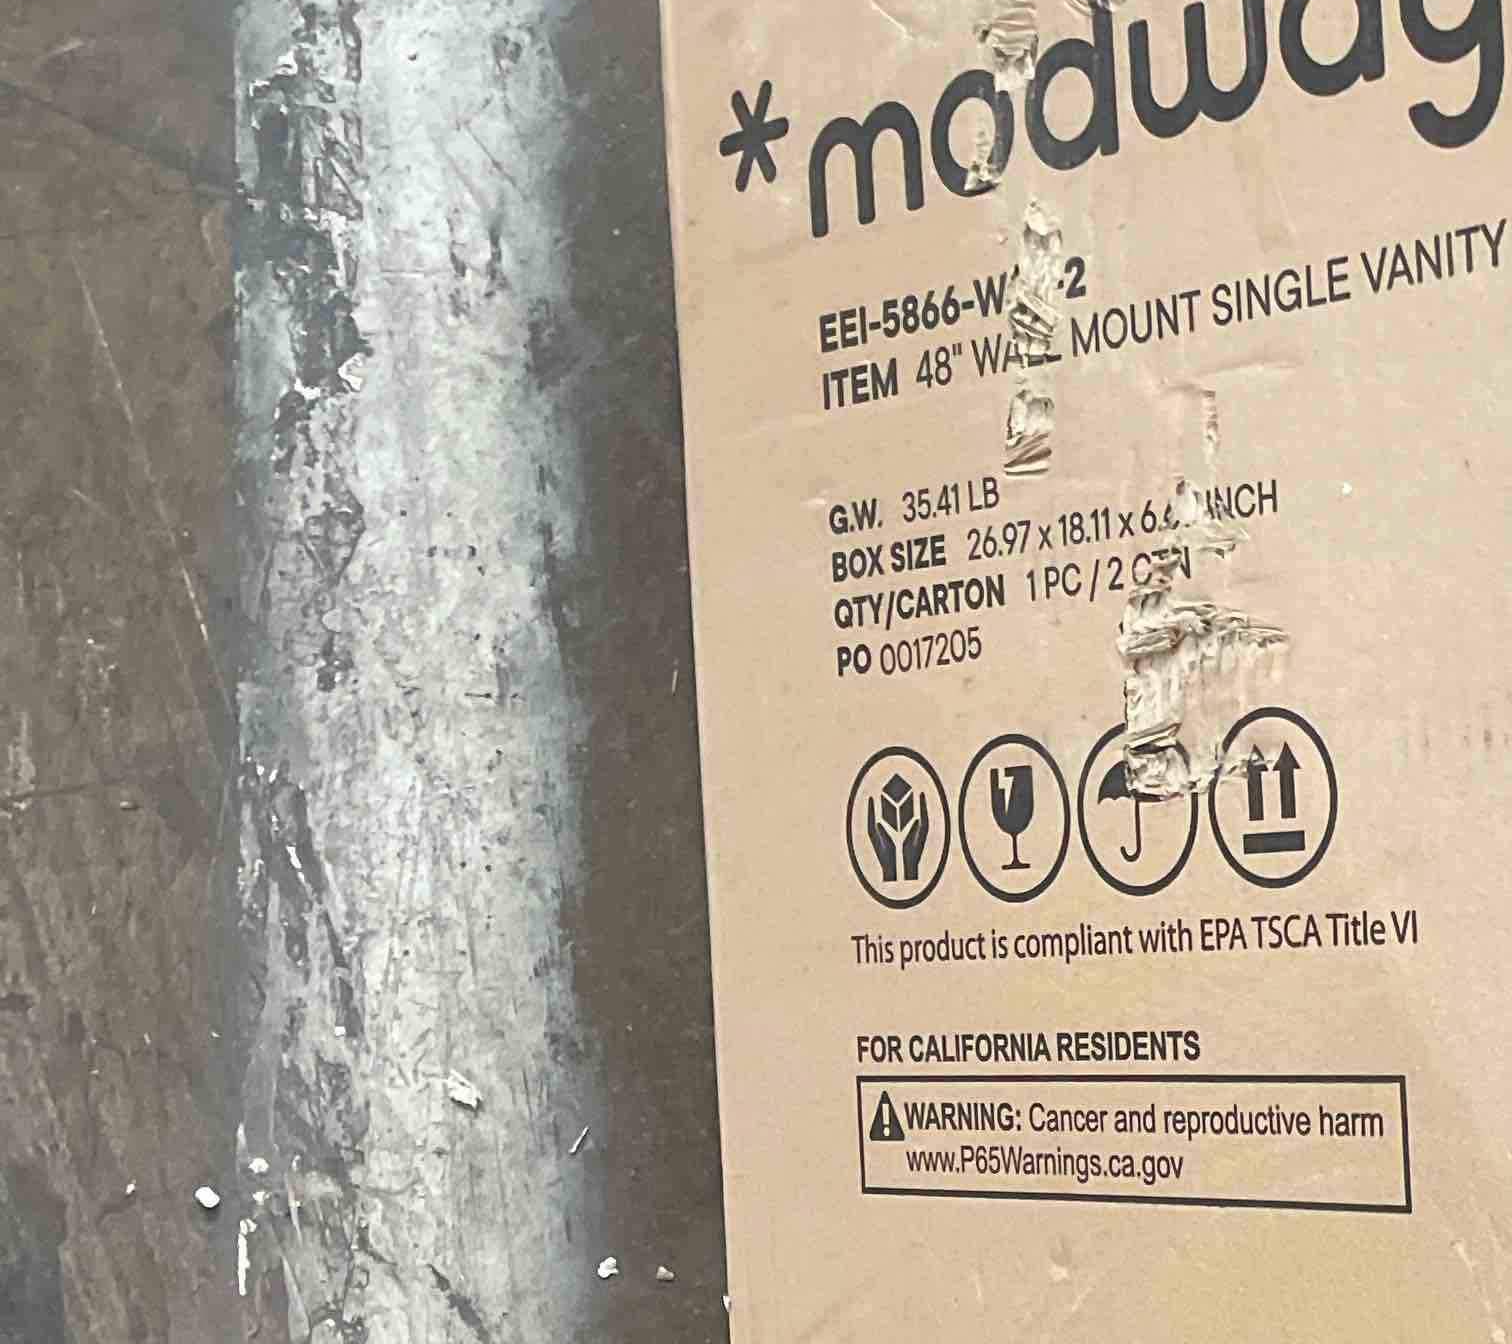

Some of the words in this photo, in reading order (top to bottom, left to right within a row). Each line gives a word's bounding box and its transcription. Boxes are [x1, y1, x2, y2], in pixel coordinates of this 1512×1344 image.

[819, 255, 1087, 354] EEI-5866-W-2
[822, 357, 899, 411] ITEM
[915, 342, 962, 389] 48"
[1070, 289, 1201, 358] MOUNT
[1211, 255, 1352, 327] SINGLE
[1359, 218, 1507, 294] VANITY
[828, 497, 883, 535] G.W.
[901, 483, 961, 524] 35.41
[967, 476, 1000, 512] LB
[831, 543, 885, 584] BOX
[889, 533, 947, 573] SIZE
[966, 519, 1031, 562] 26.97
[1057, 505, 1111, 547] 18.11
[1205, 478, 1279, 522] INCH
[833, 572, 1006, 632] QTY/CARTON
[1107, 556, 1125, 592] 2
[836, 642, 873, 678] PO
[879, 625, 983, 677] 0017205
[850, 933, 895, 964] This
[899, 929, 987, 971] product
[990, 928, 1009, 960] is
[1013, 922, 1134, 965] compliant
[1138, 918, 1194, 954] with
[1199, 917, 1248, 952] EPA
[1250, 913, 1323, 949] TSCA
[1325, 909, 1387, 947] Title
[1390, 909, 1419, 945] VI
[855, 1034, 904, 1064] FOR
[908, 1031, 1052, 1063] CALIFORNIA
[1055, 1029, 1201, 1062] RESIDENTS
[903, 1101, 1022, 1133] WARNING:
[1028, 1102, 1109, 1133] Cancer
[1113, 1103, 1156, 1134] and
[1163, 1103, 1312, 1141] reproductive
[1318, 1104, 1384, 1137] harm
[905, 1145, 1185, 1186] www.P65Warnings.ca.gov
